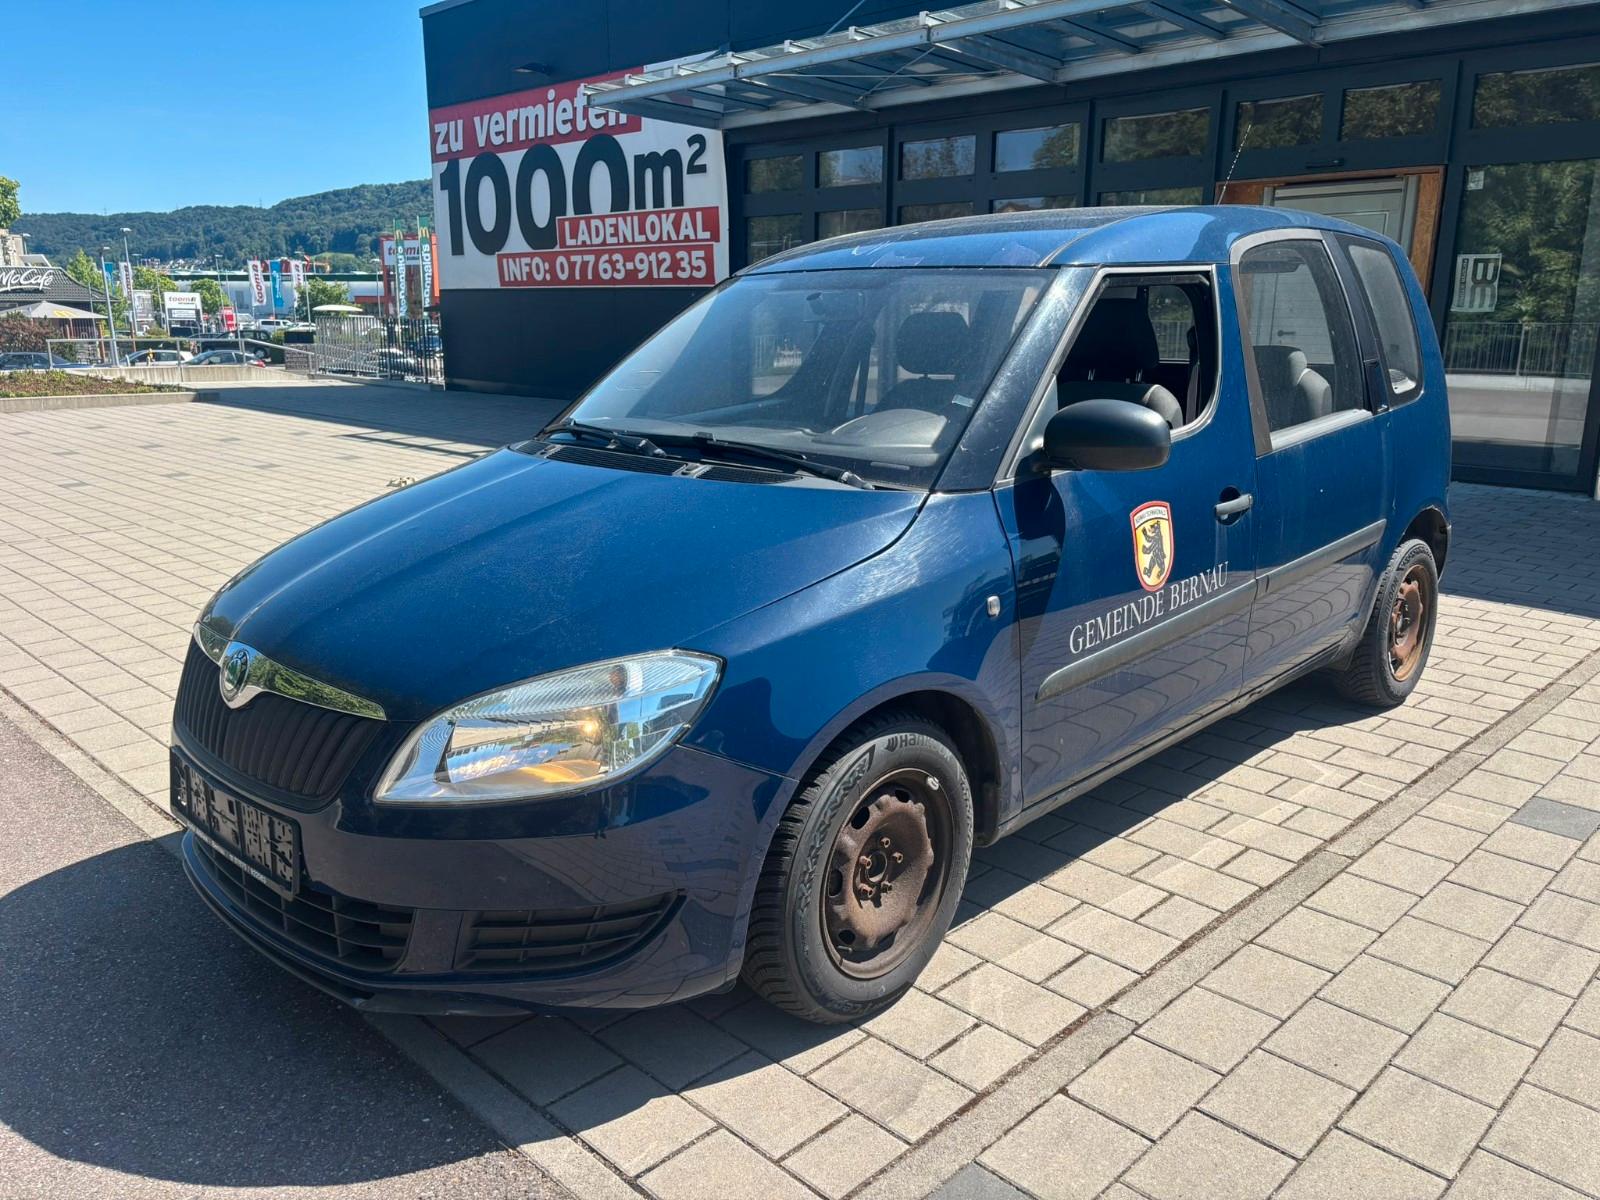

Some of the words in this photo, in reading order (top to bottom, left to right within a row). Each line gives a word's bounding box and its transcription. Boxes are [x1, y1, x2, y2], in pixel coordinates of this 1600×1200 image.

[434, 119, 464, 155] zu
[564, 211, 711, 246] LADENLOKAL
[502, 256, 551, 282] INFO:
[1069, 590, 1165, 654] GEMEINDE
[1169, 561, 1230, 611] BERNAU
